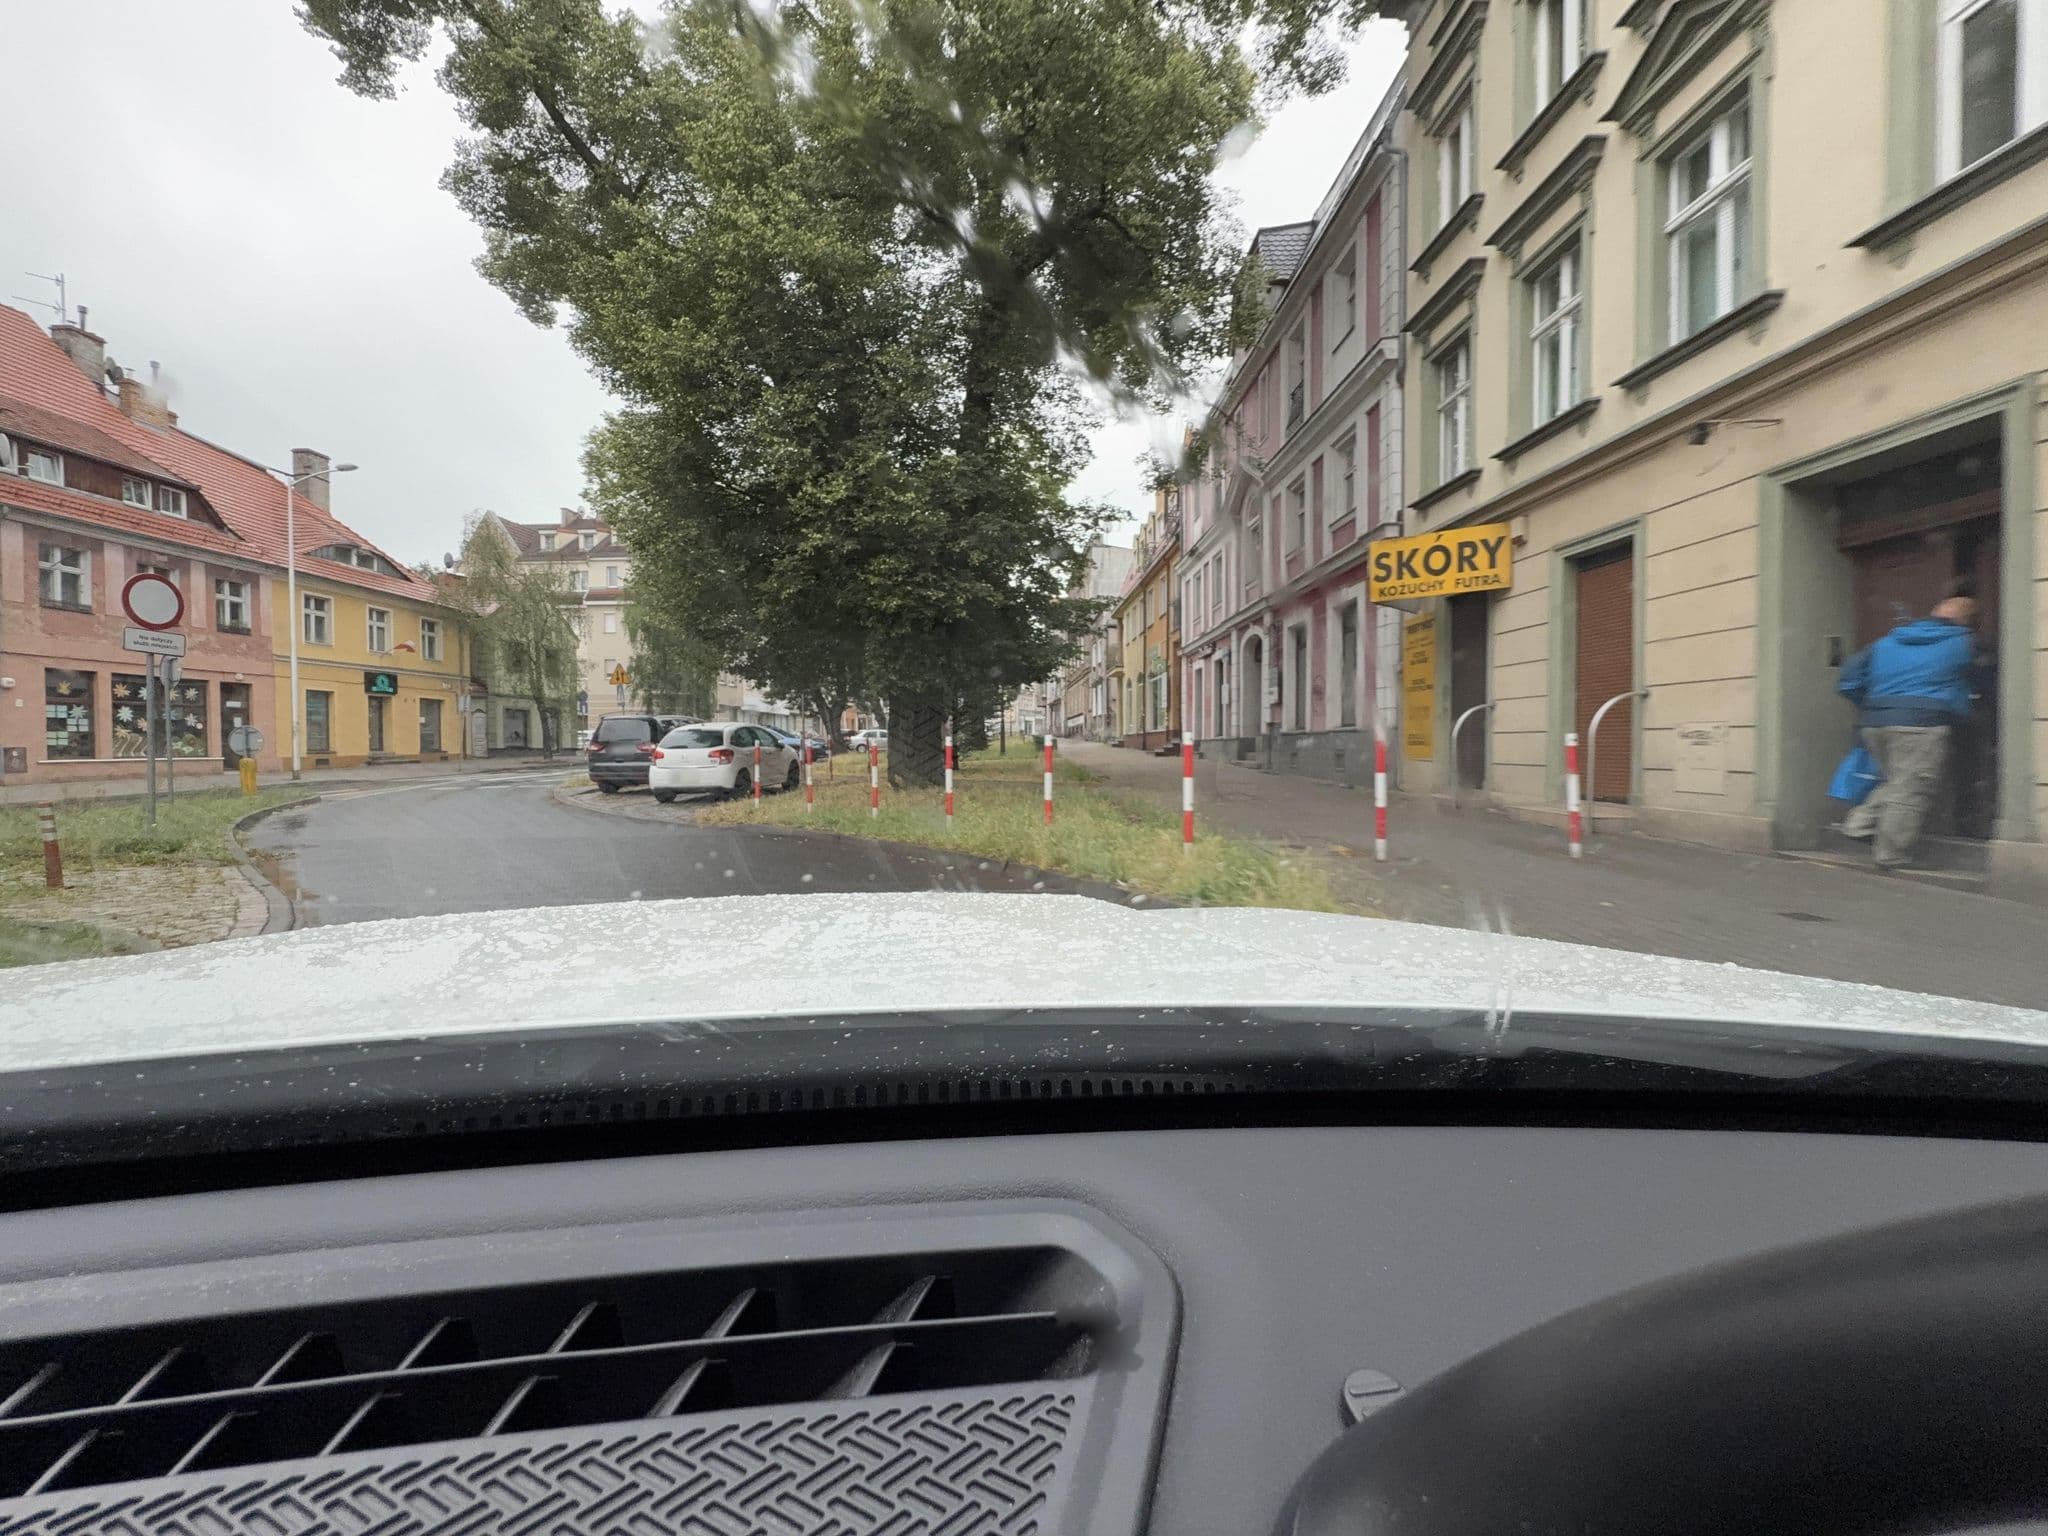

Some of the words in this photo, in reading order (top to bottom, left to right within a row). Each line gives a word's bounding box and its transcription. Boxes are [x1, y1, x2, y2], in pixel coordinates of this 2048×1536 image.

[1374, 534, 1506, 583] SKÓRY
[1378, 580, 1445, 597] KOŻUCHY
[1455, 574, 1502, 589] FUTRA
